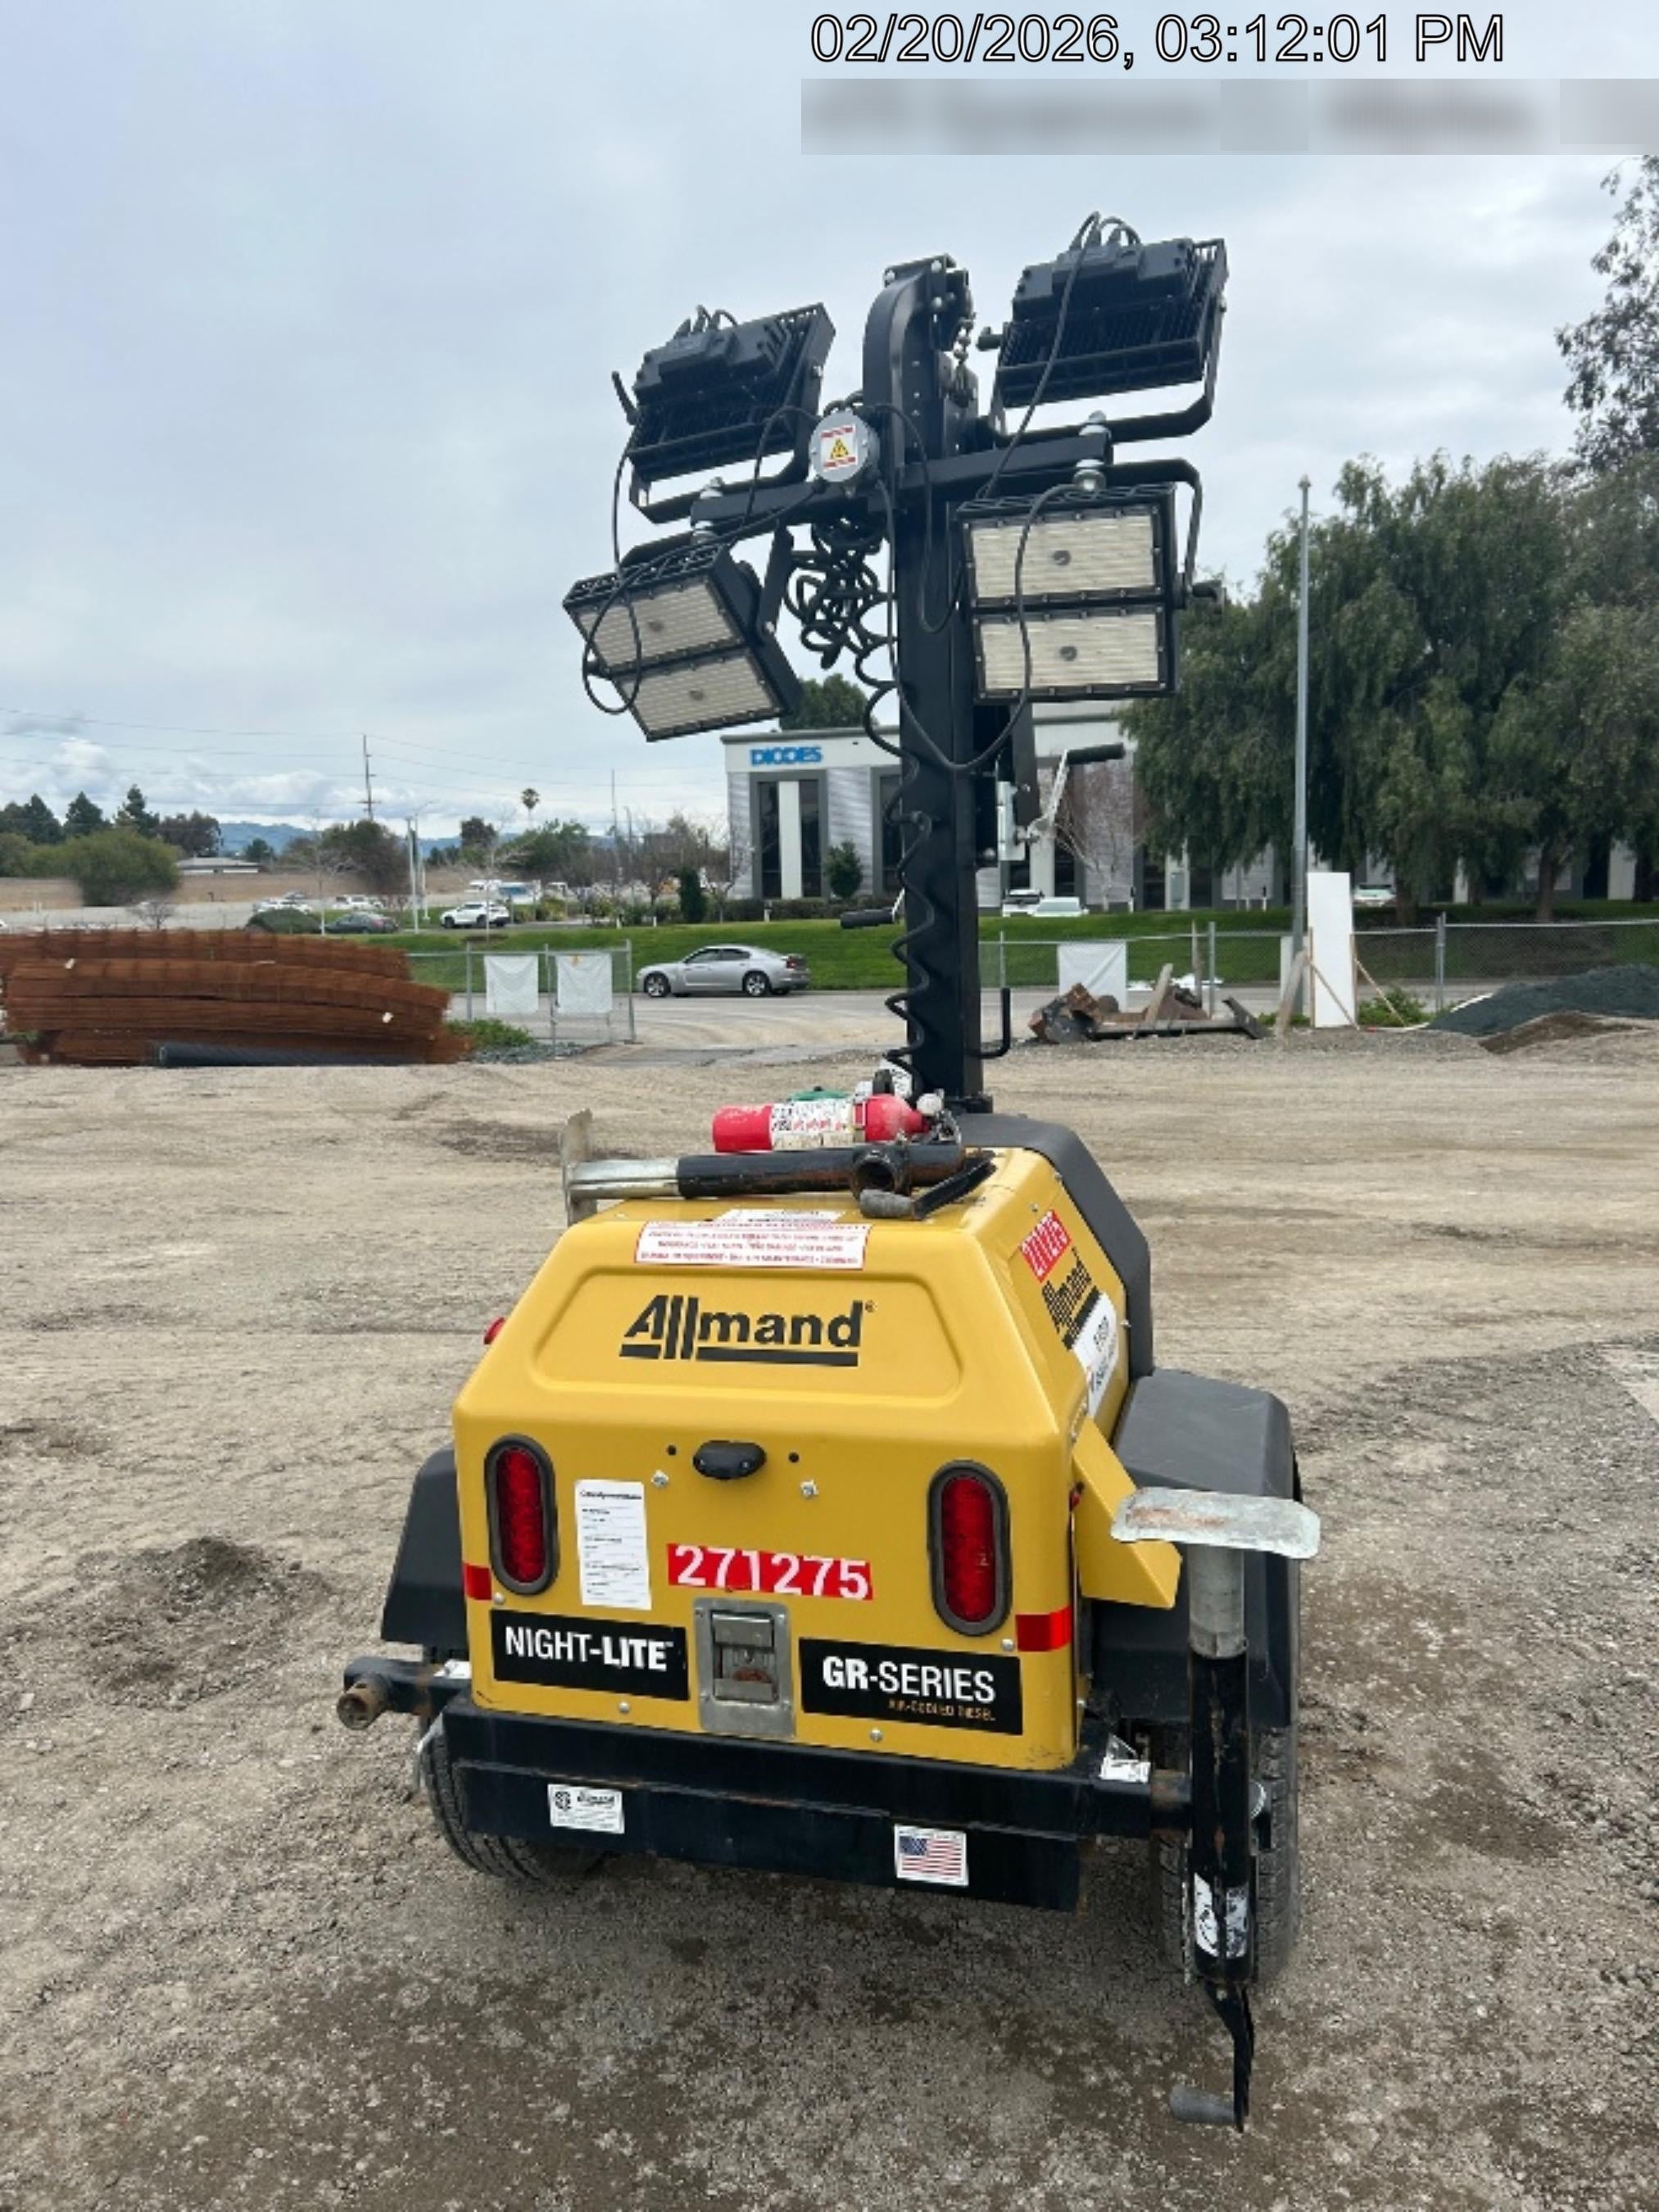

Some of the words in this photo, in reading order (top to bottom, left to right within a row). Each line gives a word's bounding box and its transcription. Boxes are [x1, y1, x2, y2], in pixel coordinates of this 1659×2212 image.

[623, 1294, 863, 1360] Allmand
[673, 1544, 870, 1600] 271275
[822, 1656, 996, 1702] GR-SERIES
